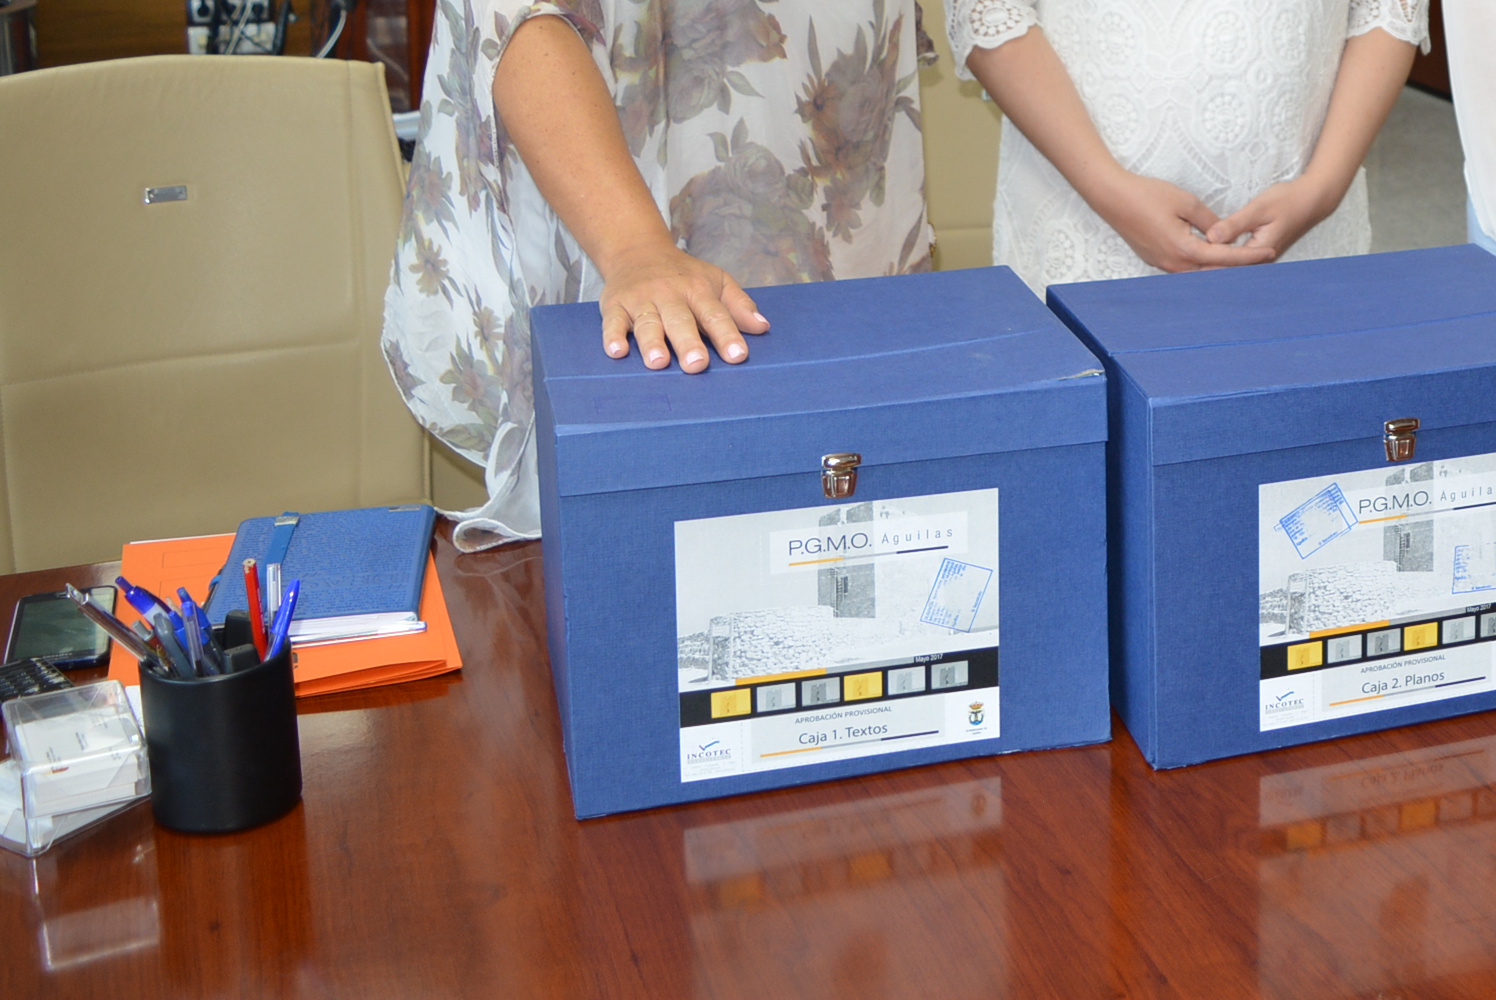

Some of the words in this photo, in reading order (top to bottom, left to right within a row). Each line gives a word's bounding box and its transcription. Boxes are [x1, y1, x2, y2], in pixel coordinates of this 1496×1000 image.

[1359, 490, 1432, 514] P.G.M.O.
[788, 532, 872, 556] P.G.M.O.
[881, 528, 953, 545] Águilas
[915, 655, 929, 663] Mayo
[930, 653, 943, 661] 2017
[1360, 661, 1403, 674] APROBACIÓN
[1404, 654, 1446, 667] PROVISIONAL
[1361, 681, 1388, 695] Caja
[1391, 678, 1402, 689] 2.
[1405, 671, 1445, 687] Planos
[795, 710, 843, 724] APROBACIÓN
[844, 705, 893, 718] PROVISIONAL
[798, 731, 827, 746] Caja
[832, 729, 842, 740] 1.
[844, 724, 888, 739] Textos
